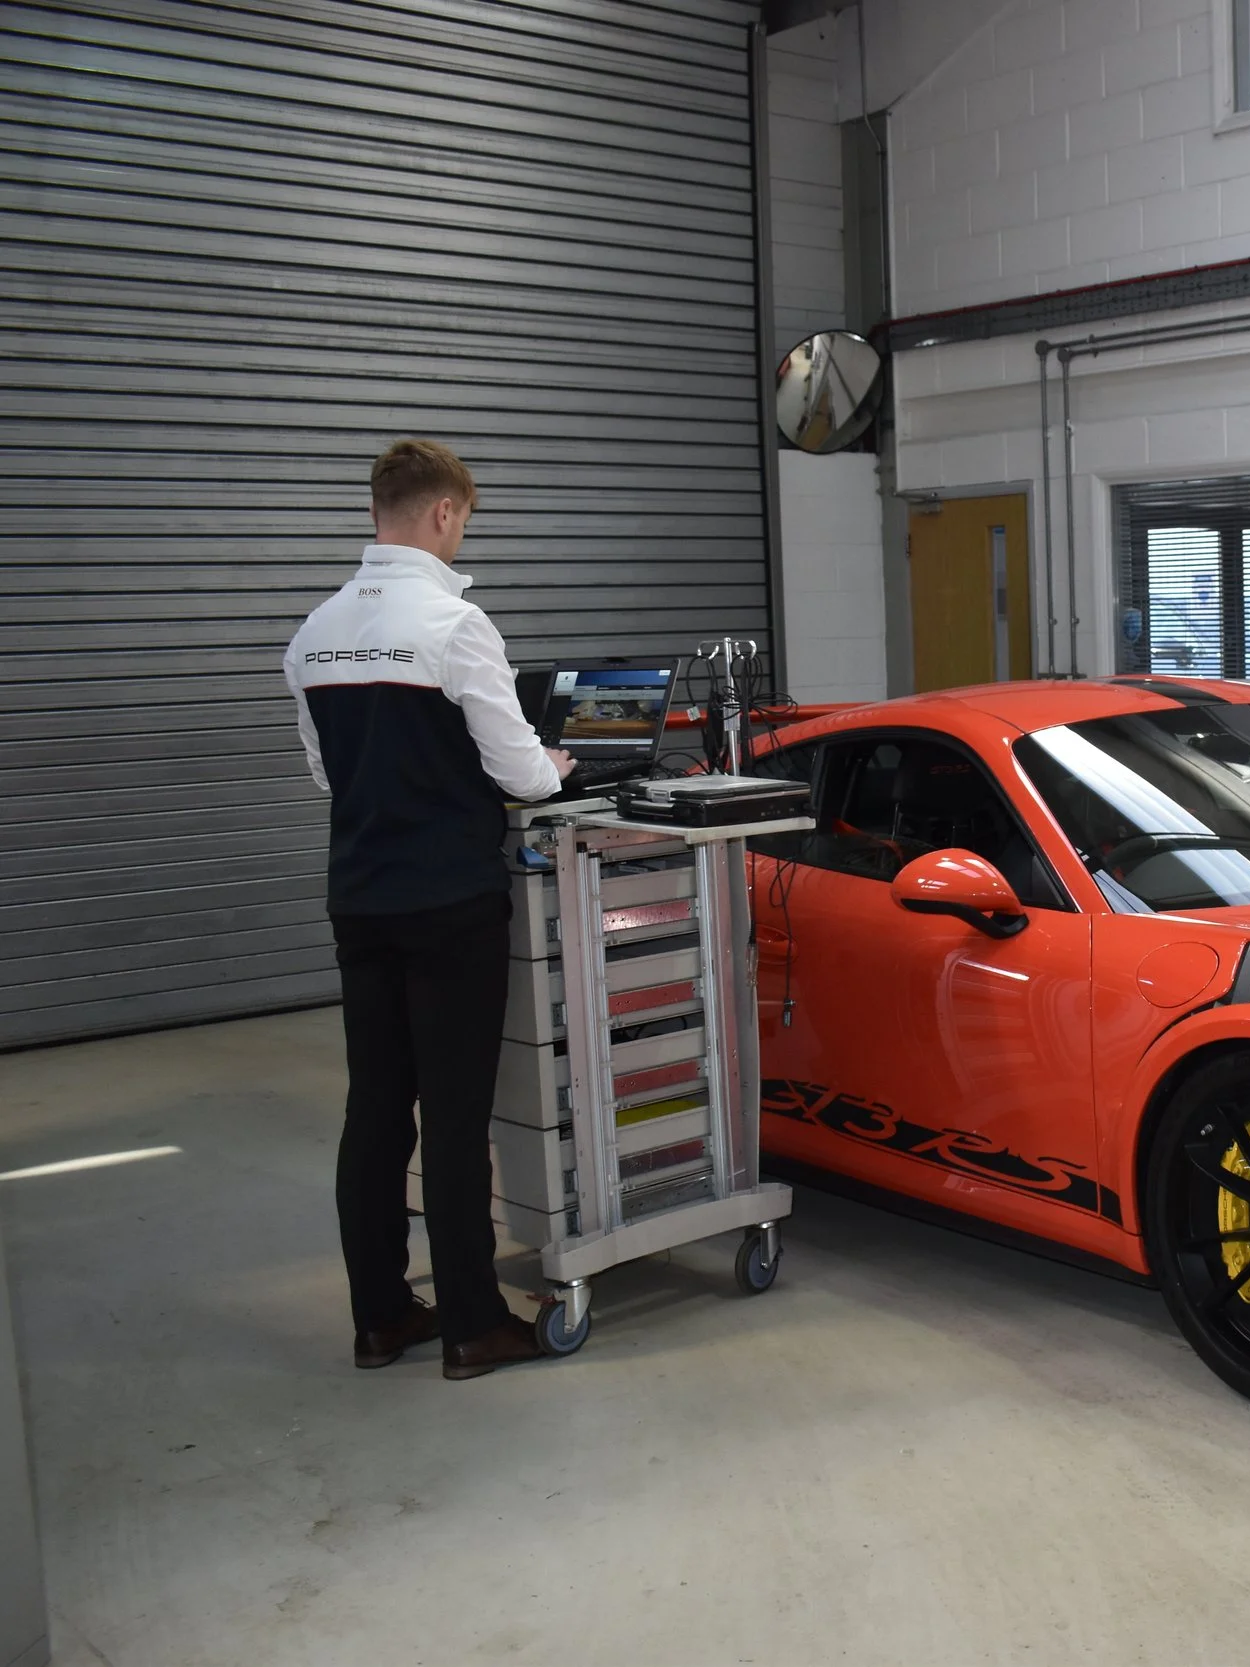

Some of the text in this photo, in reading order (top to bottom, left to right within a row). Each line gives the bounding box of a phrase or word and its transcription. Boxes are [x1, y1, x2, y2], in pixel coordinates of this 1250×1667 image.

[358, 587, 383, 596] BOSS
[305, 648, 415, 665] PORSCHE
[908, 1128, 1088, 1192] RS
